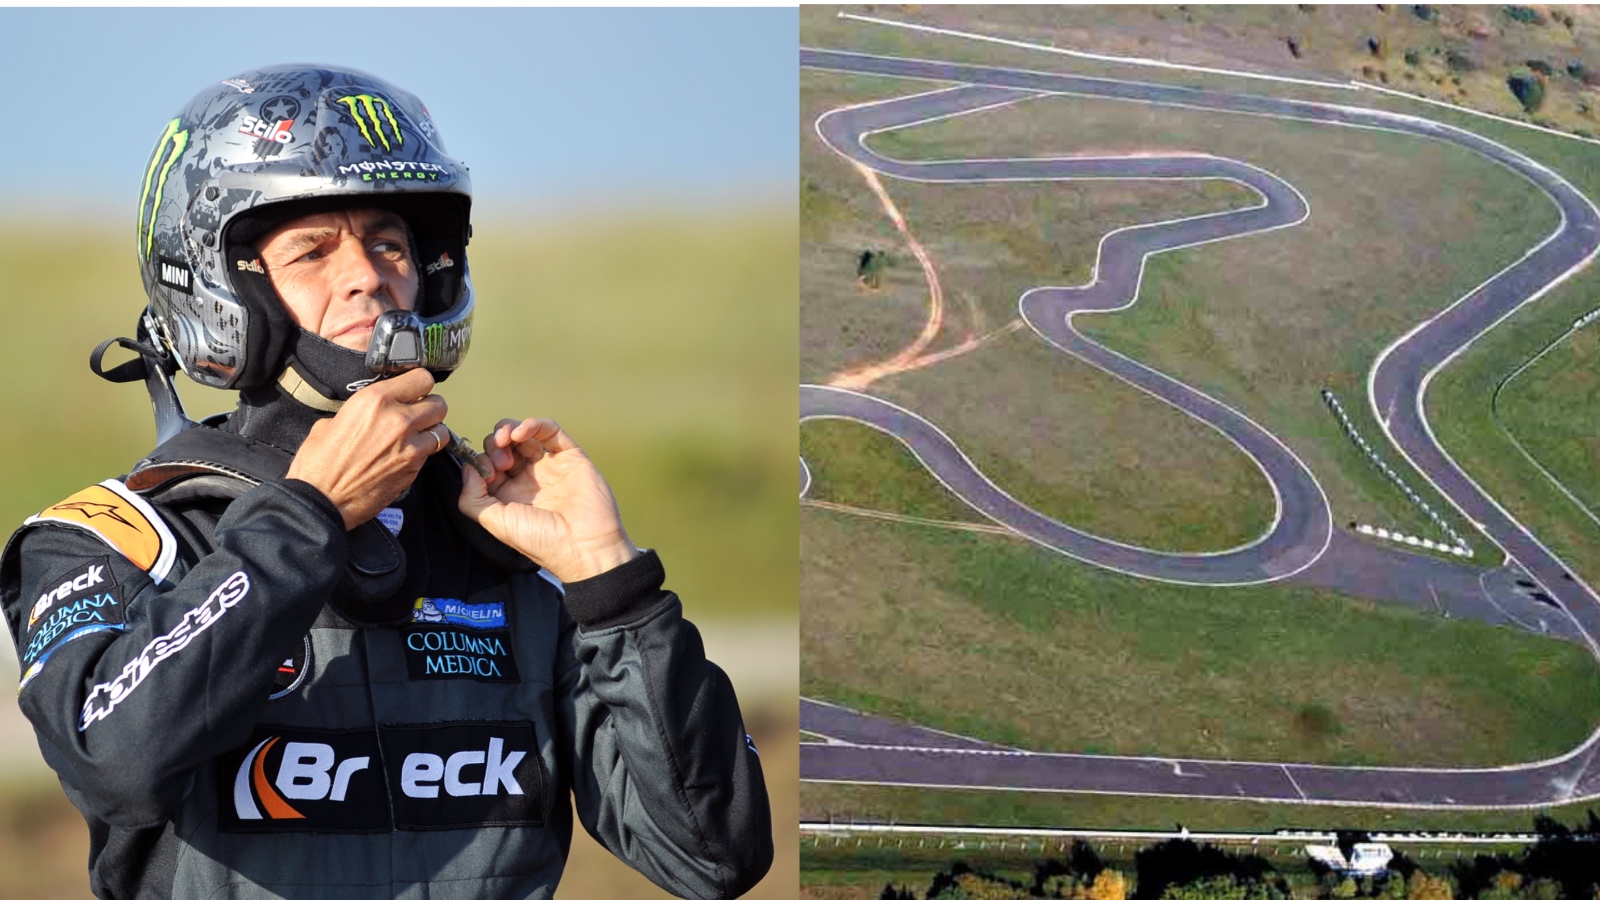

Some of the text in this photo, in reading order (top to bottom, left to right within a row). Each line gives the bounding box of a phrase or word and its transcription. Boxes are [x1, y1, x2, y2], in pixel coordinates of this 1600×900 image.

[363, 172, 437, 181] ENERGY
[161, 262, 189, 287] MINI
[33, 565, 104, 619] Breck
[444, 604, 502, 619] MICHELIN
[23, 593, 118, 661] COLUMNA
[29, 610, 105, 664] MEDICA
[78, 571, 250, 732] alpinestars
[407, 632, 507, 656] COLUMNA
[426, 655, 503, 677] MEDICA
